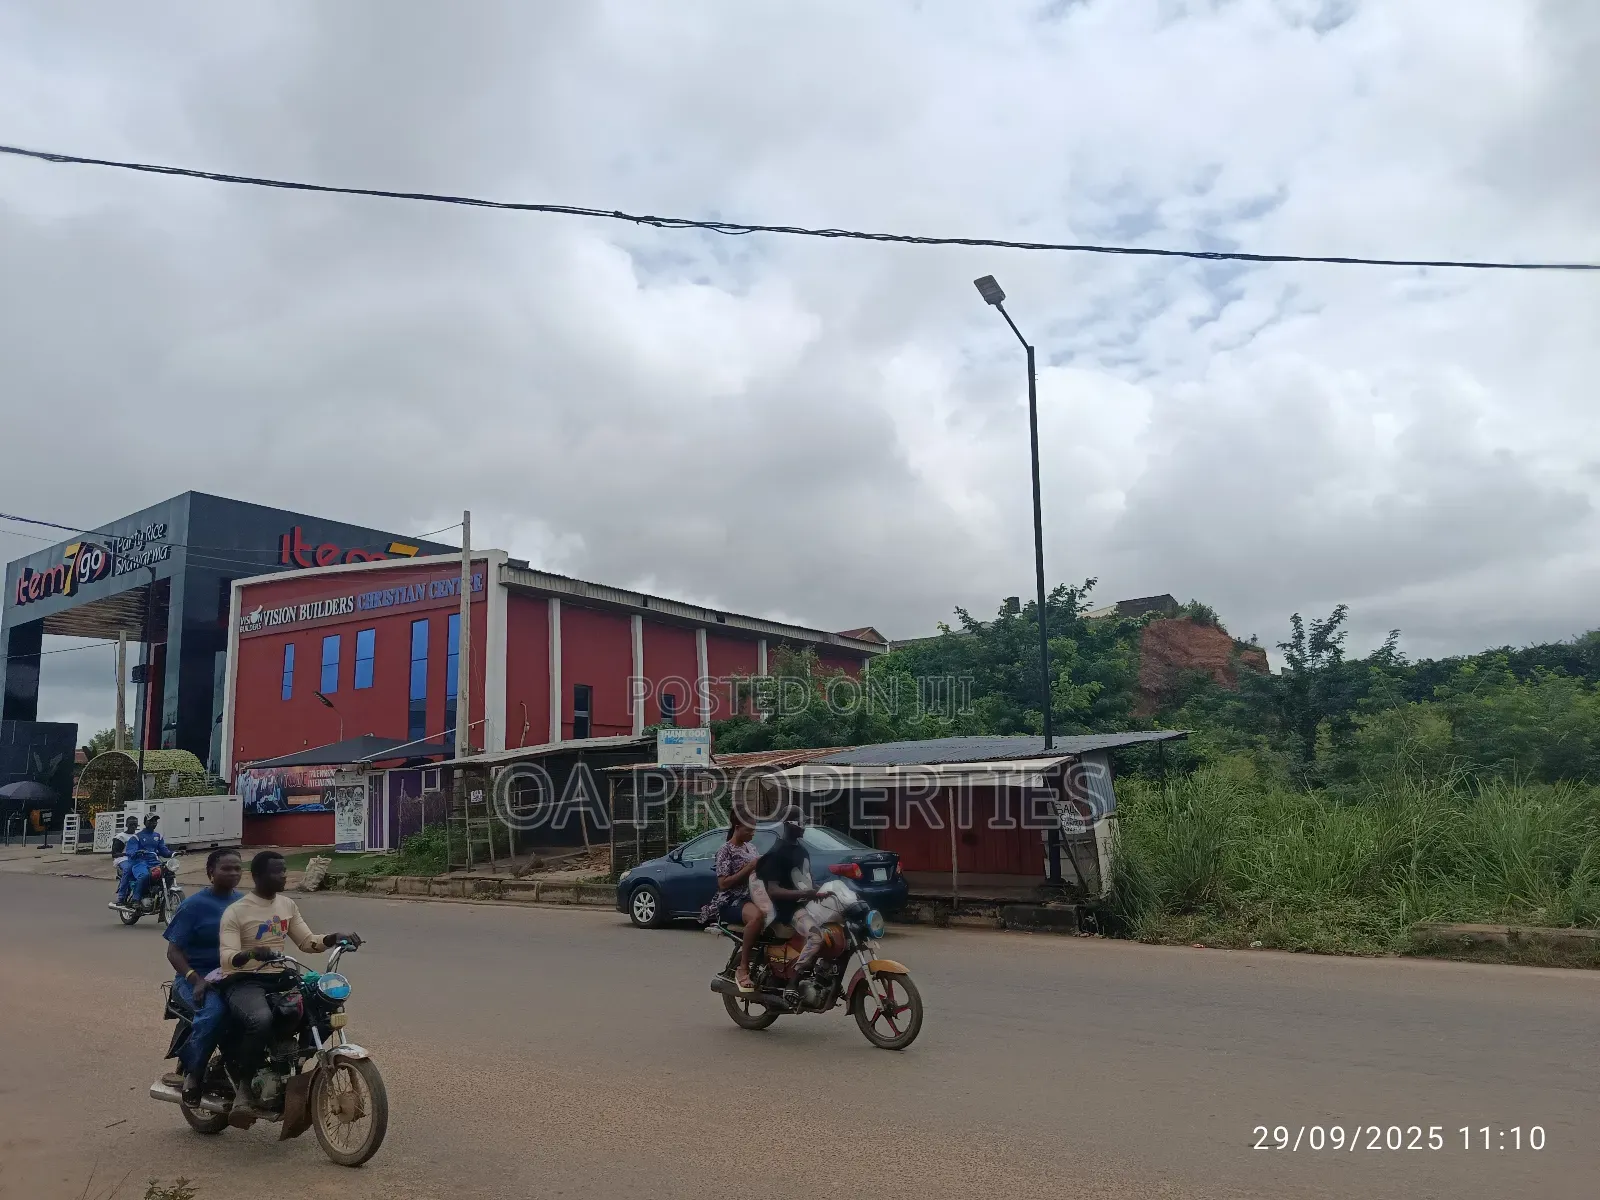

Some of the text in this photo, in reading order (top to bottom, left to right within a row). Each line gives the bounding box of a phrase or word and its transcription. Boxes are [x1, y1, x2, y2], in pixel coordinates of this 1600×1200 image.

[117, 523, 163, 553] Party Rice
[264, 573, 483, 626] VISION BUILDERS CHRISTIAN CENTE
